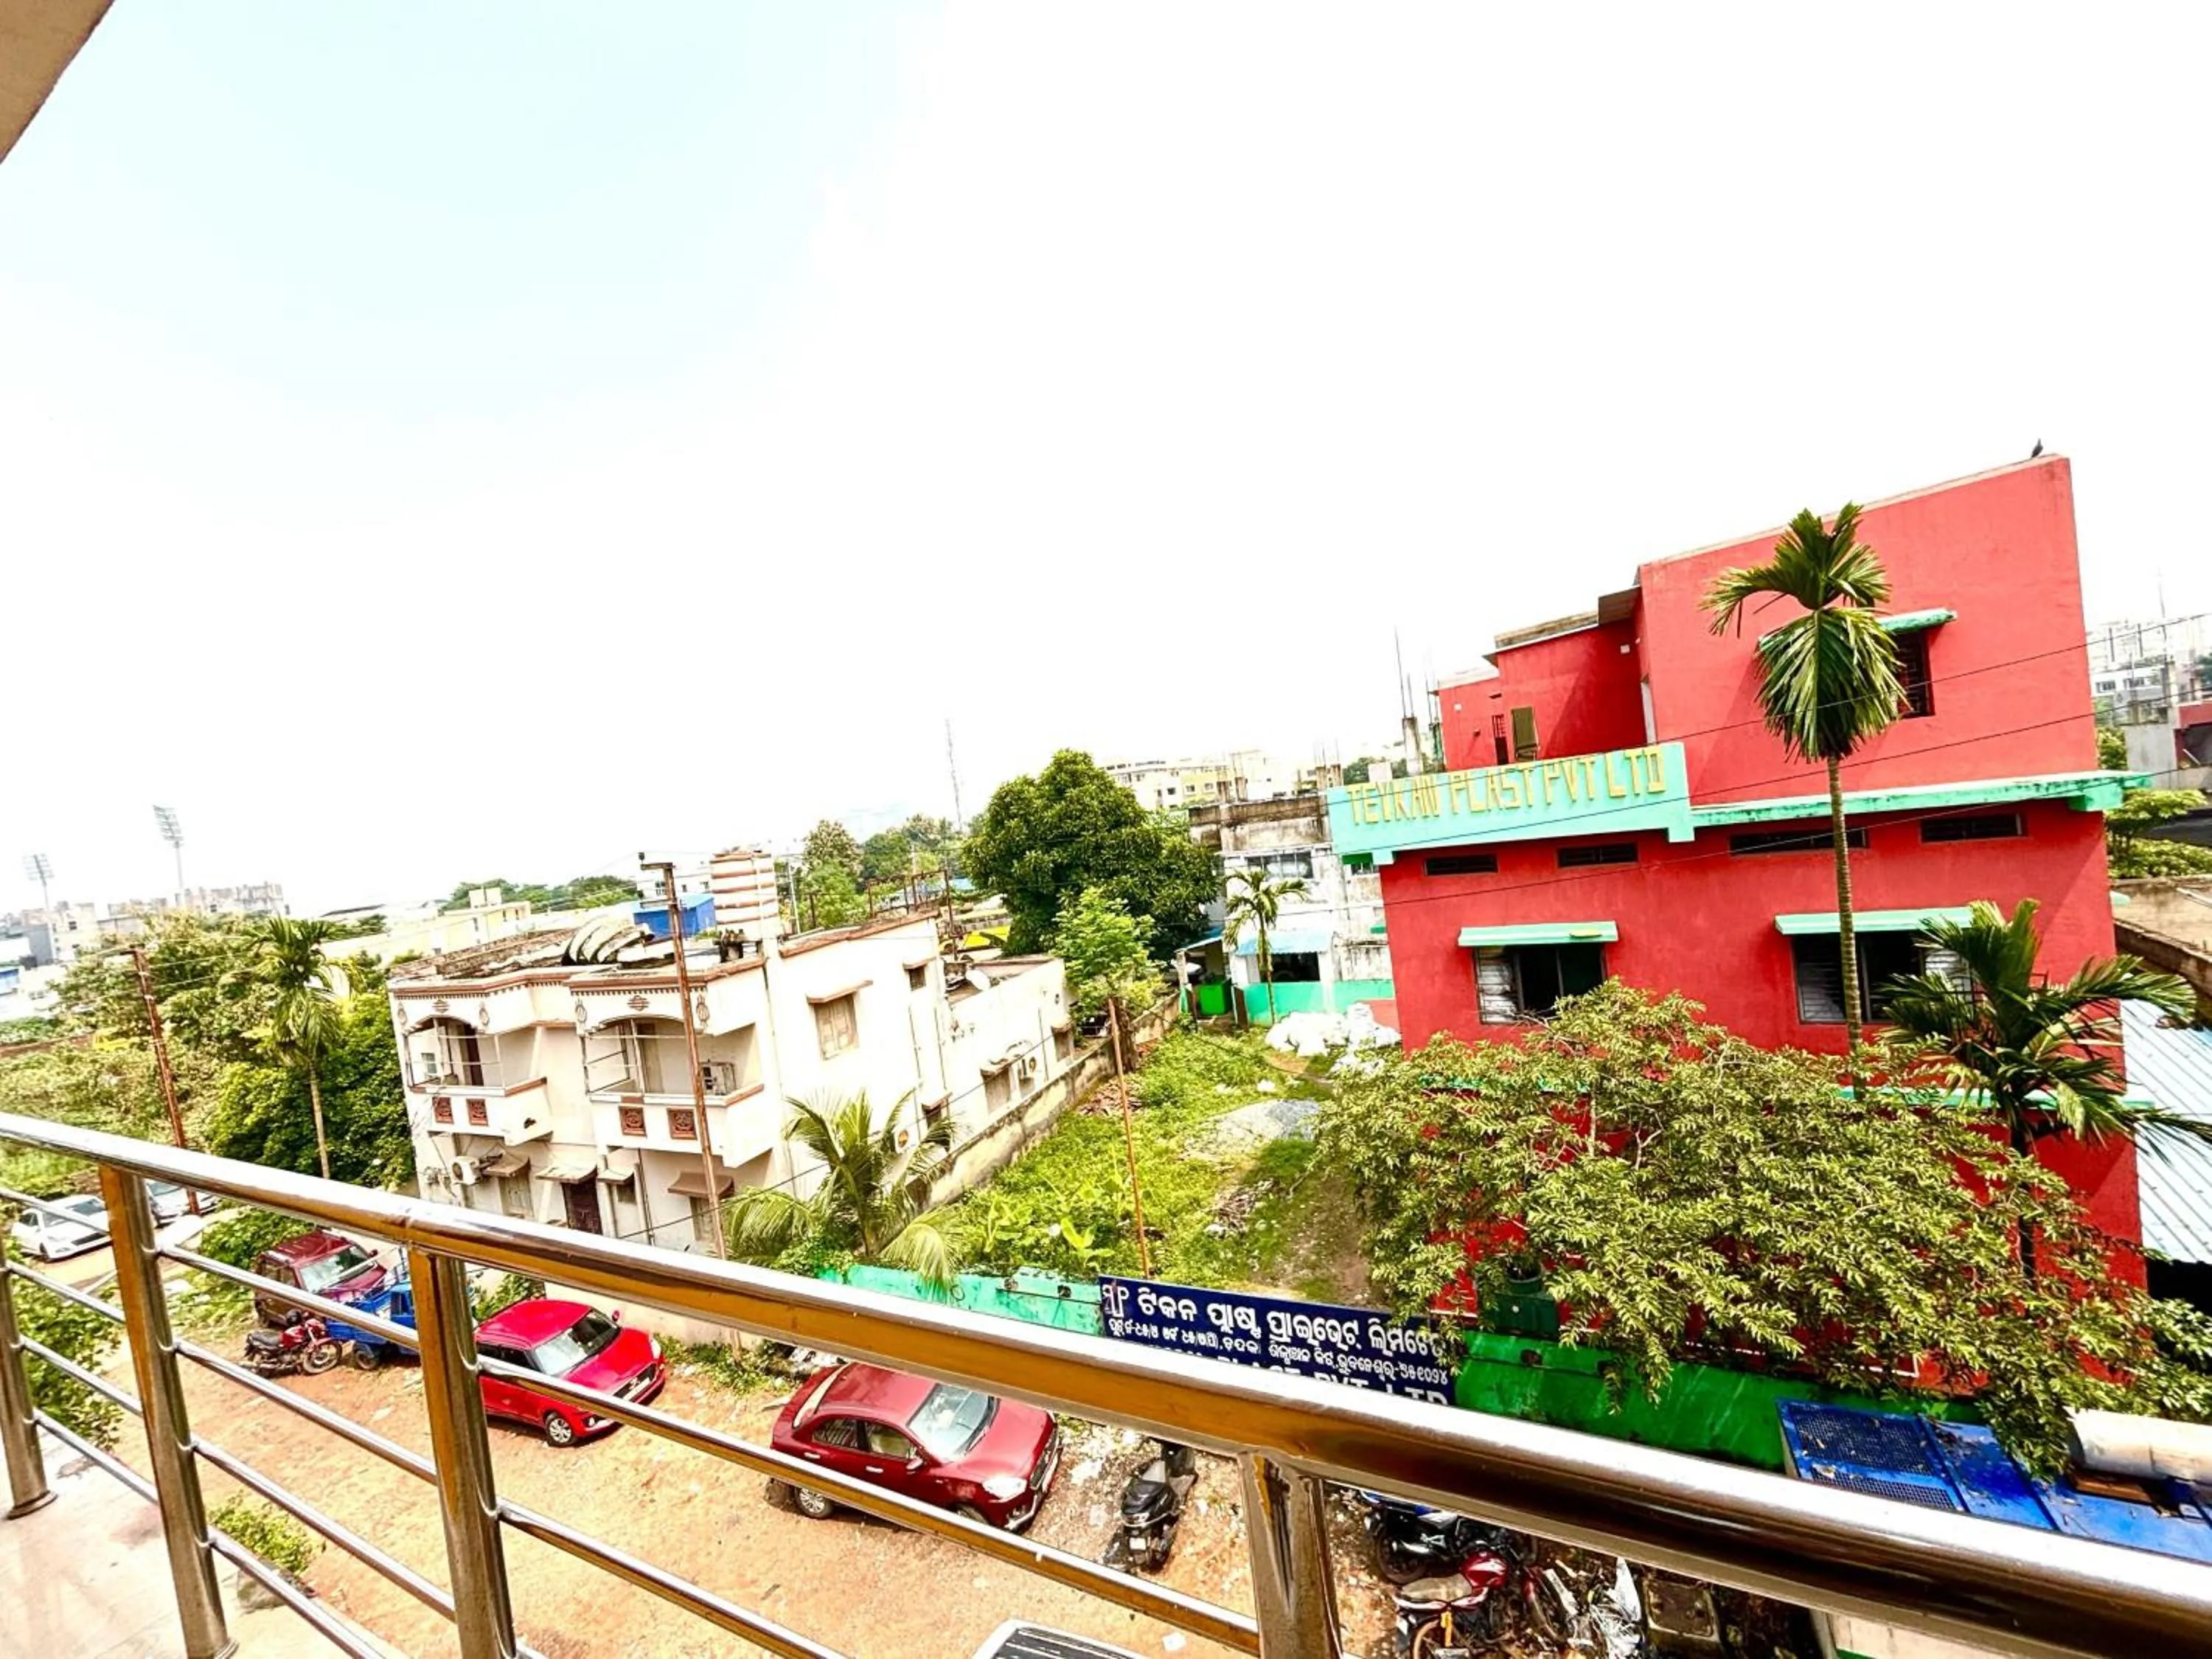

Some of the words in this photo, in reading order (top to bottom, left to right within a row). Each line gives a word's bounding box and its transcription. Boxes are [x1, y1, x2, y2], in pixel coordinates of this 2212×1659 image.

[1449, 762, 1534, 815] PLAST
[1543, 754, 1596, 805] PVT
[1605, 748, 1667, 799] LTD
